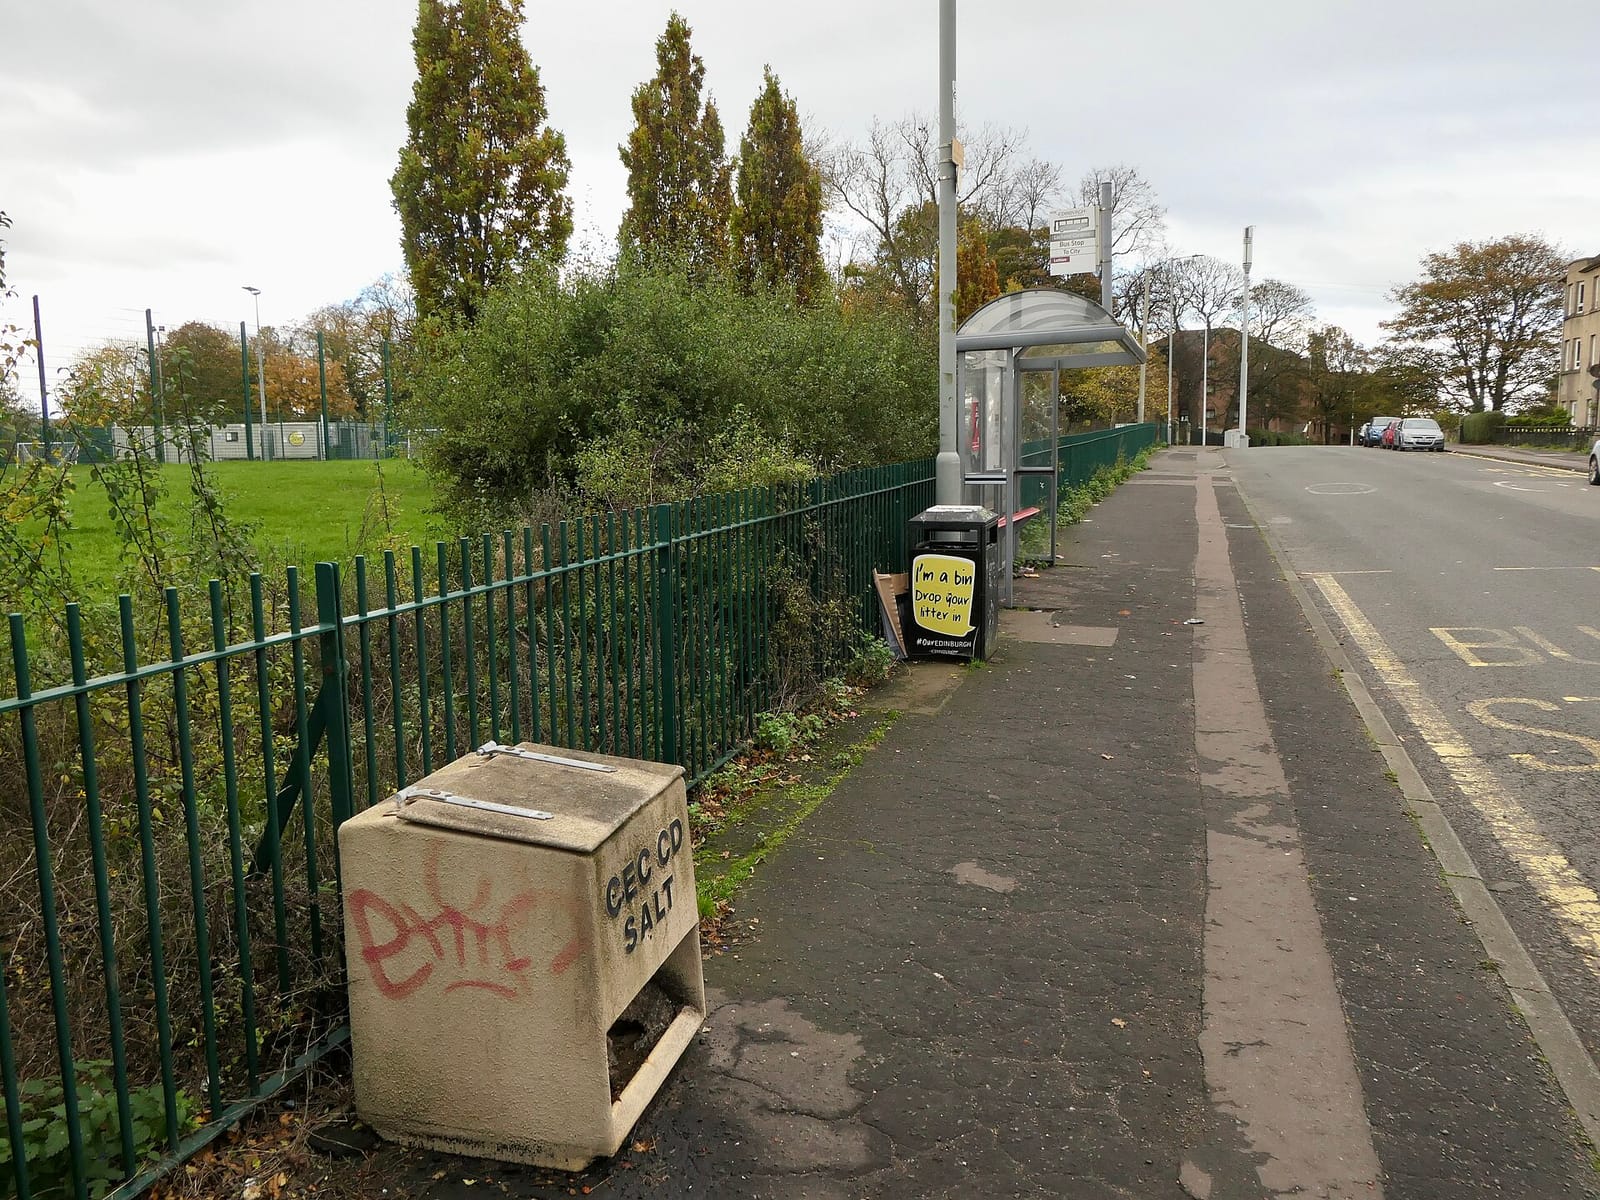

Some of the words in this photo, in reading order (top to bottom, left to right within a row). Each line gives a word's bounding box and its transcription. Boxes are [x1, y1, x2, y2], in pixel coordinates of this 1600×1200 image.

[915, 563, 934, 583] I'm
[939, 571, 948, 583] a
[954, 568, 973, 586] bin
[915, 589, 942, 603] Drop
[945, 592, 970, 608] your
[920, 605, 949, 620] litter
[952, 608, 961, 622] in
[605, 847, 653, 919] CEC
[656, 817, 683, 866] CD
[624, 874, 674, 955] SALT
